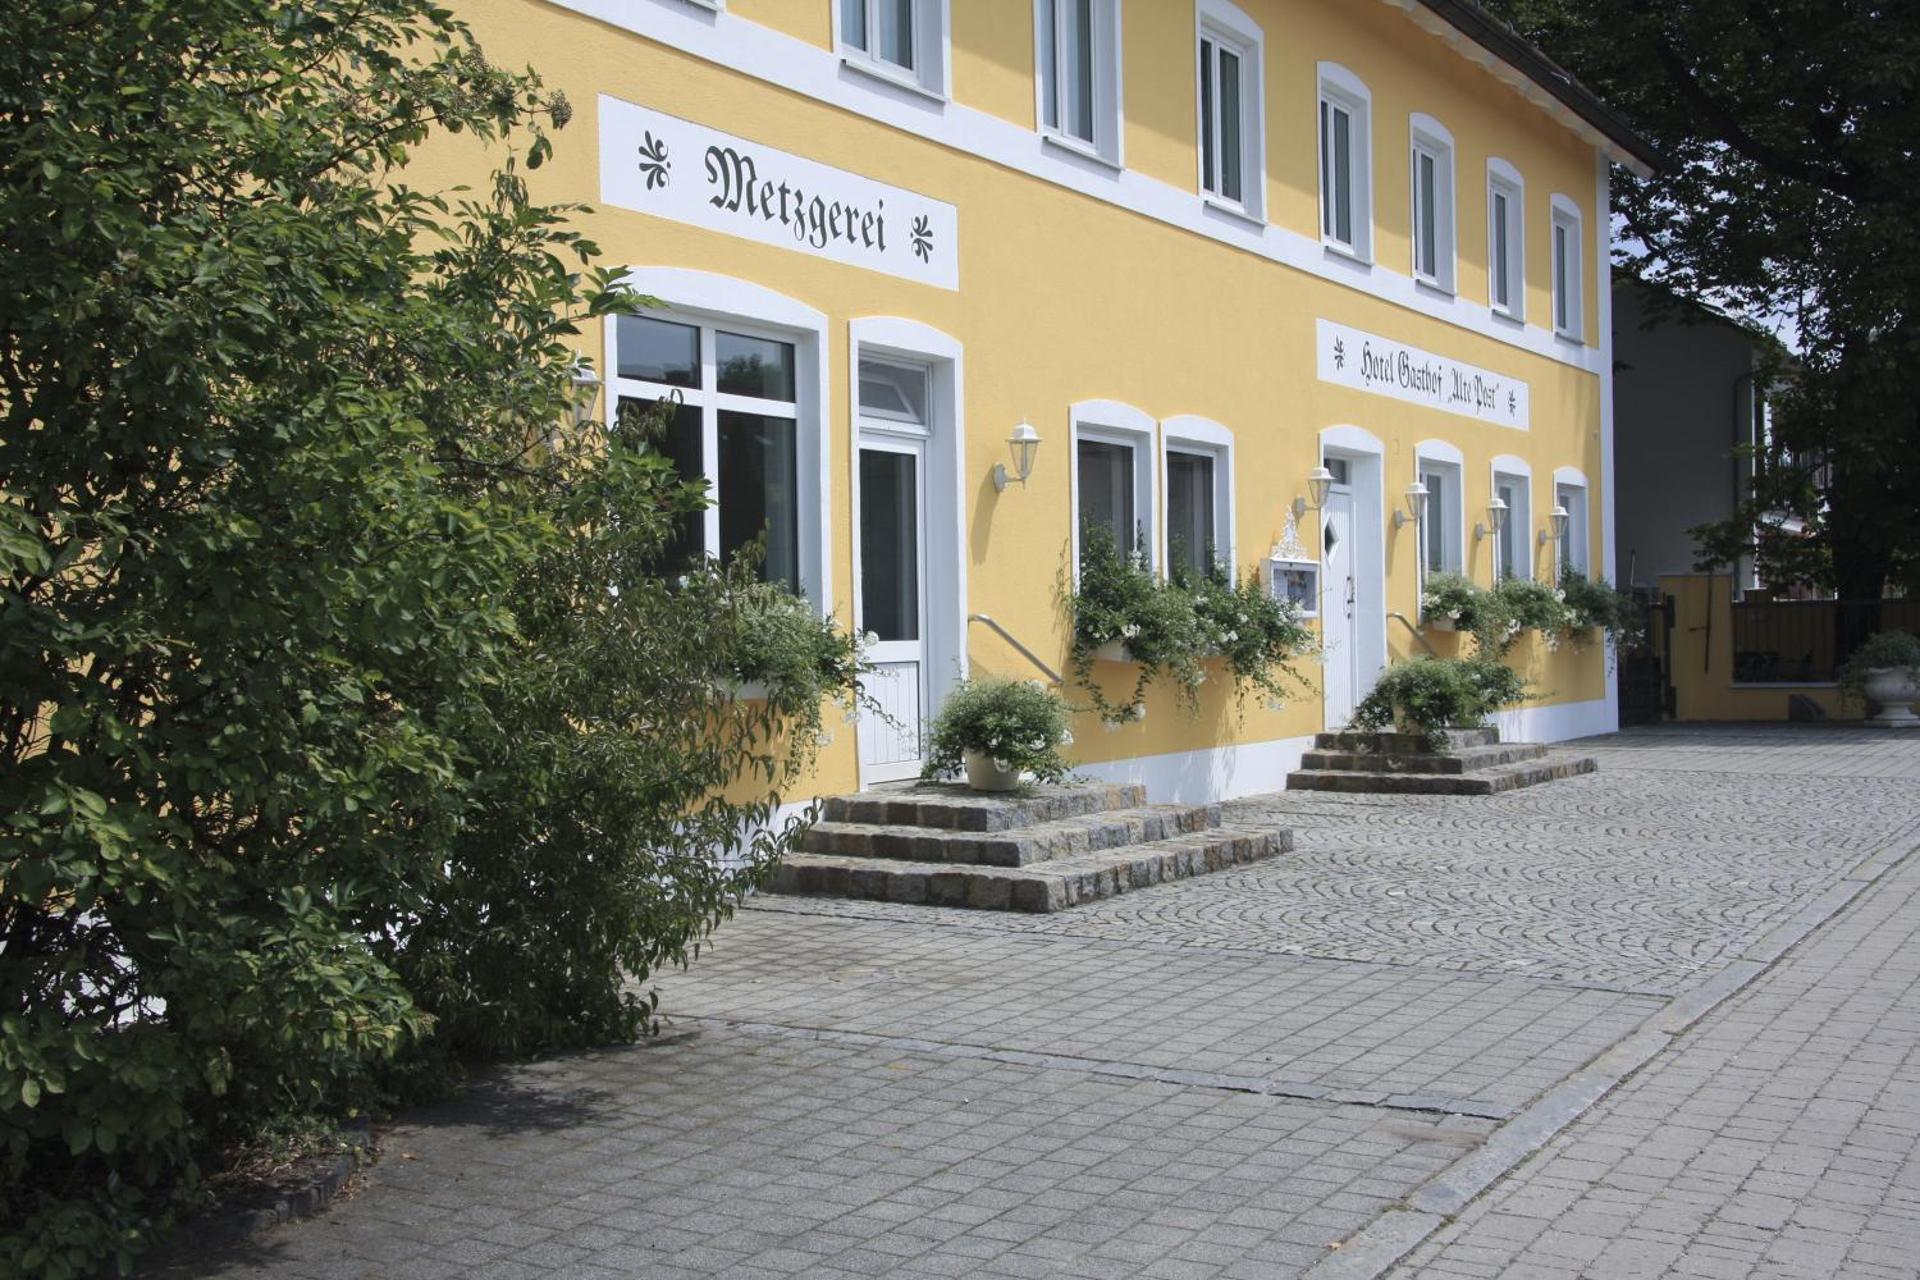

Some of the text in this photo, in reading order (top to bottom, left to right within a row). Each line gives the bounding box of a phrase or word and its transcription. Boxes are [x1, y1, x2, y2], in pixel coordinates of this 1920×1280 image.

[705, 146, 886, 252] Metzgerei
[1361, 341, 1394, 386] Hotel
[1398, 350, 1442, 400] Gasthof
